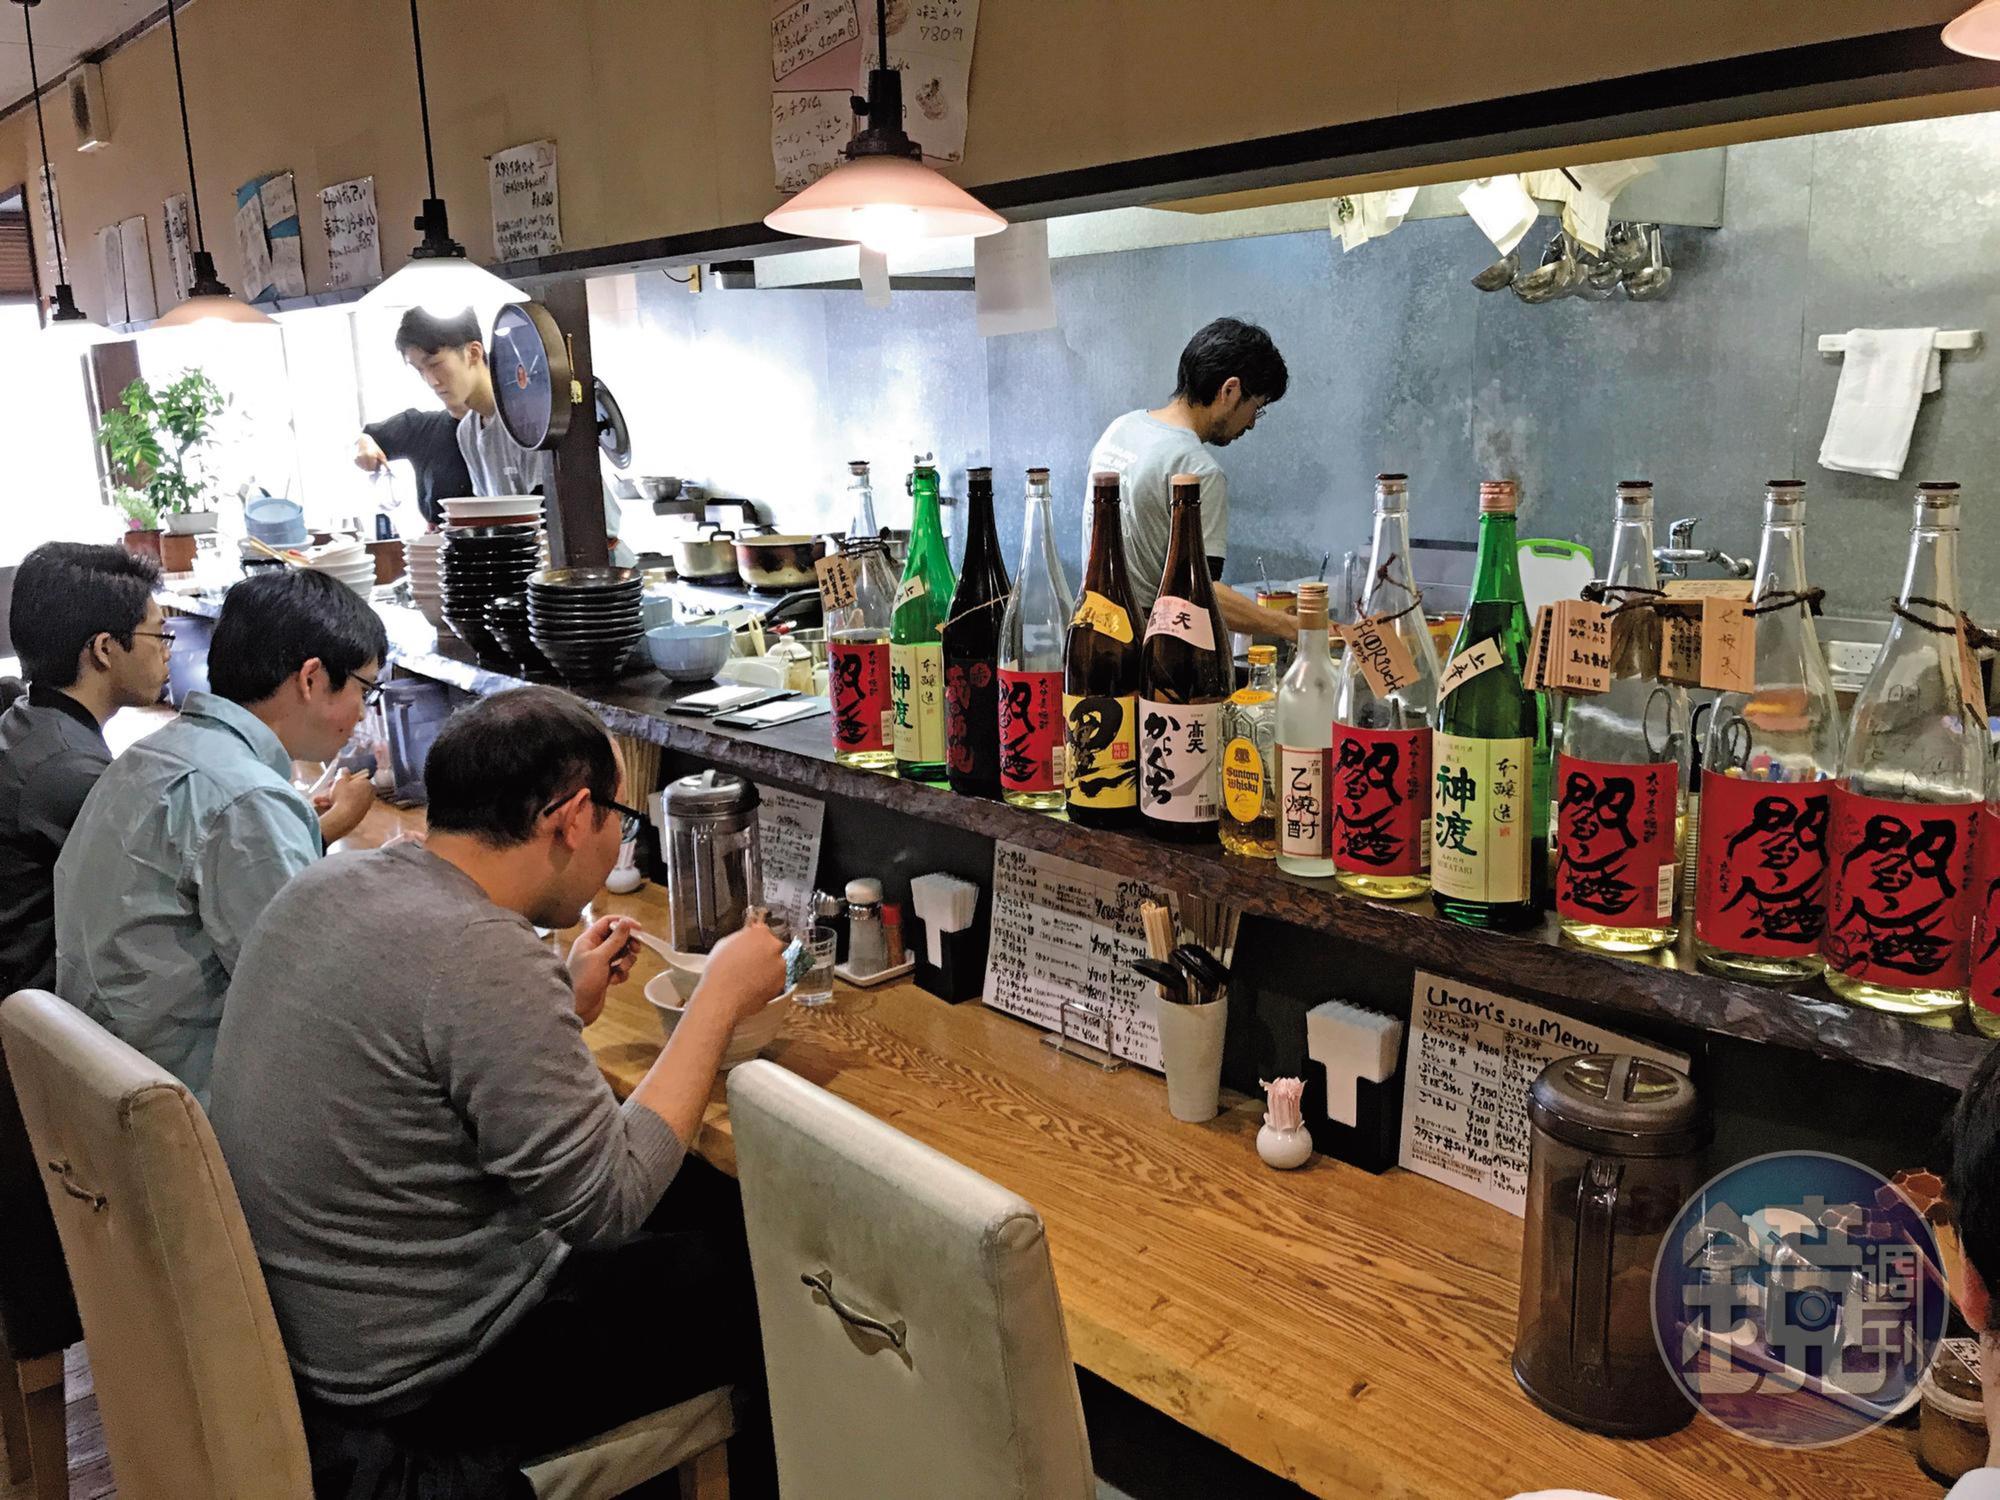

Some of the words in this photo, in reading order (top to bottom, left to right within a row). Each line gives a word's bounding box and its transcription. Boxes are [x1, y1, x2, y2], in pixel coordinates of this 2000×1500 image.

[1144, 712, 1181, 804] からくち
[1226, 766, 1260, 783] Suntory
[1227, 778, 1259, 795] Whisky
[1435, 764, 1477, 857] 神渡
